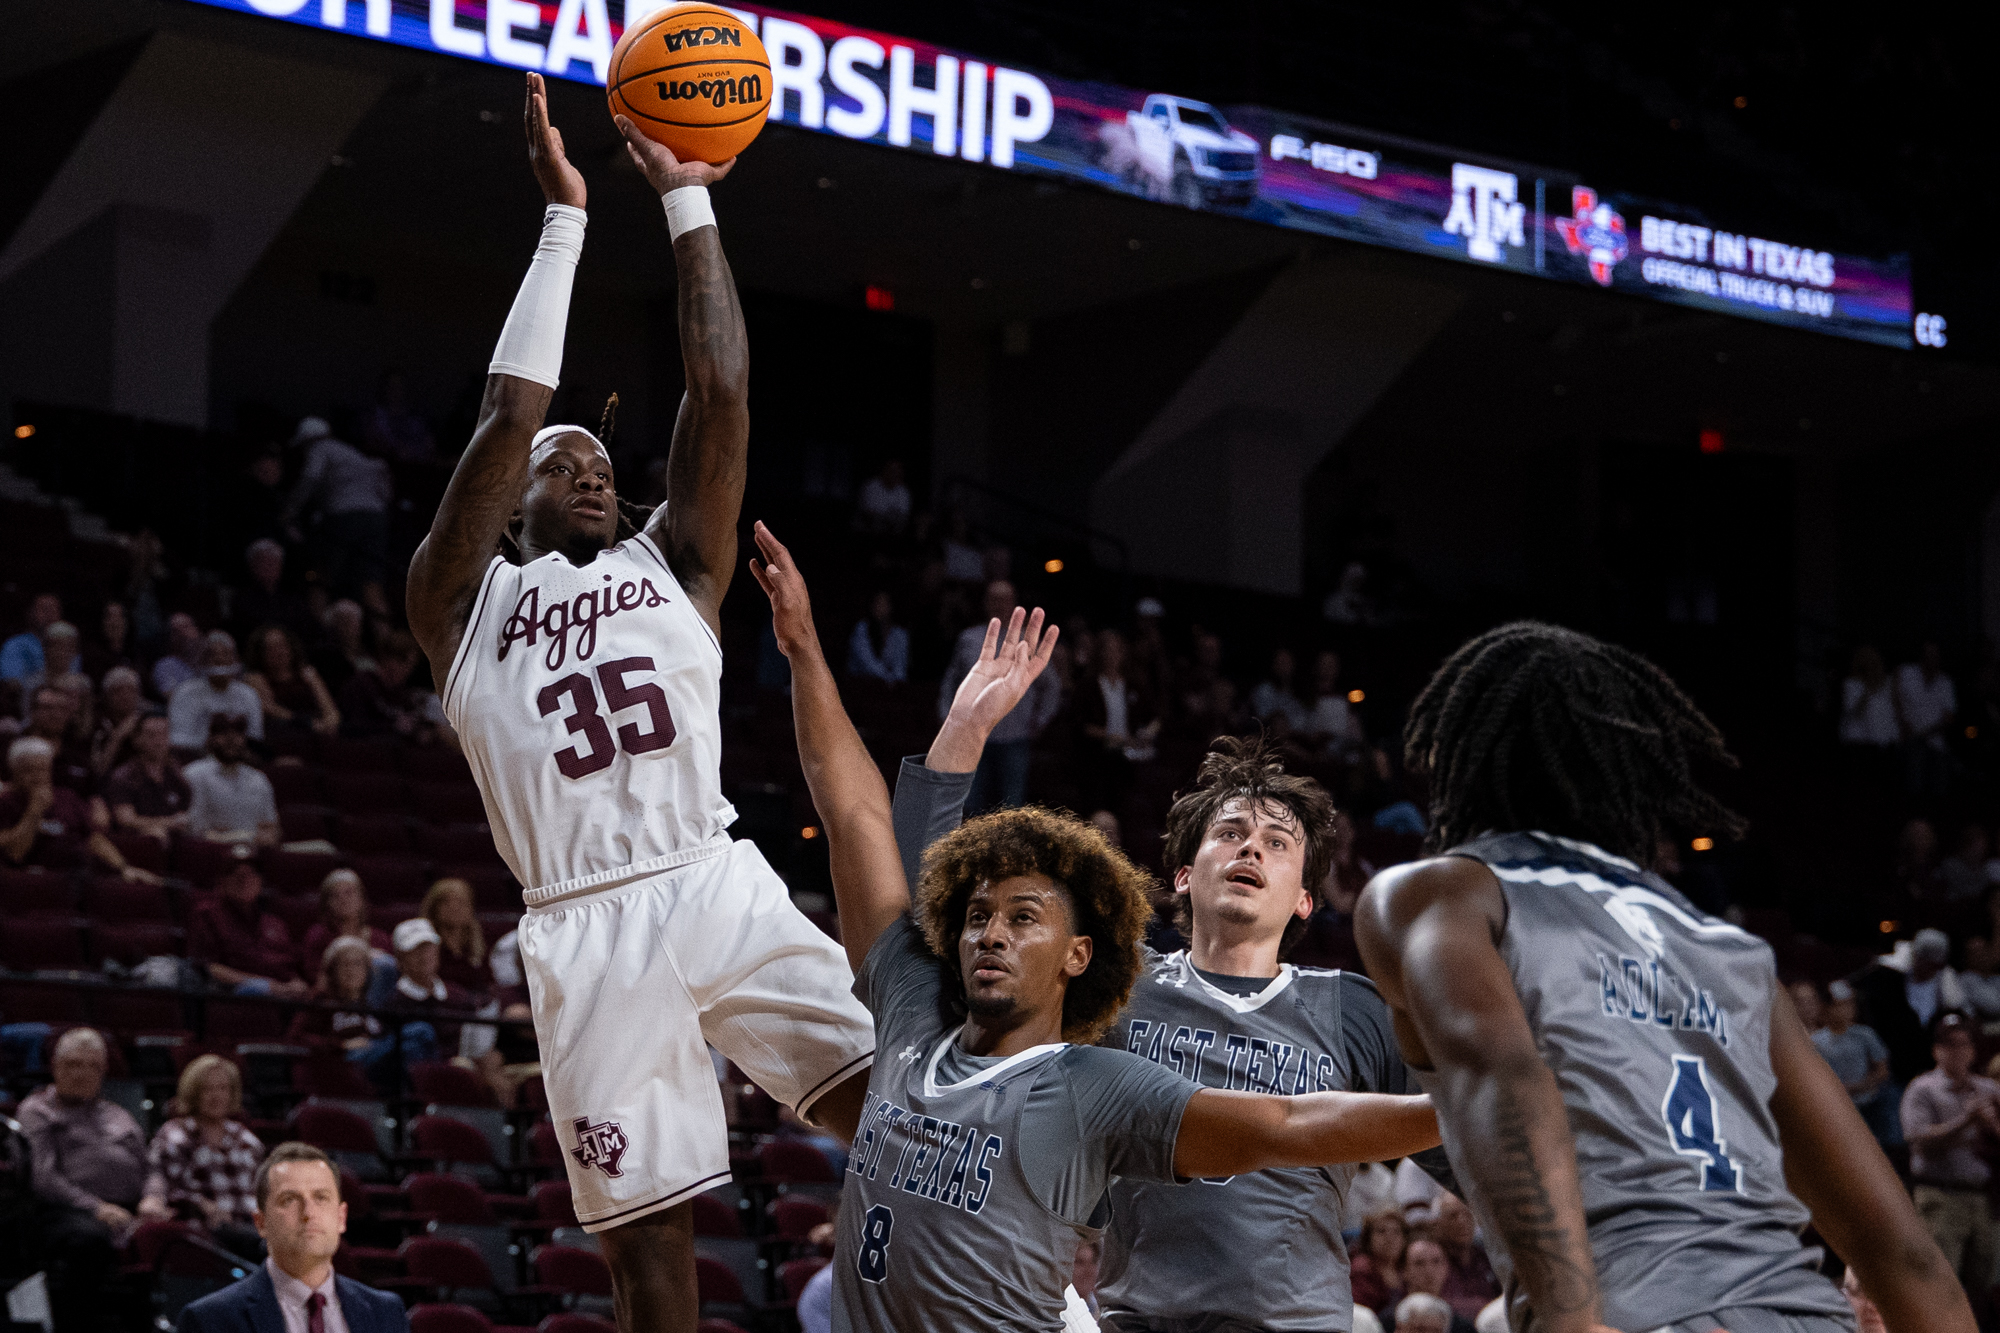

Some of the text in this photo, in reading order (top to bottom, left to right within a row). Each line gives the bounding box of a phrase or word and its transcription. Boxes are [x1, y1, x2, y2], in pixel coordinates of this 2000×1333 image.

[663, 26, 741, 53] NCAA
[429, 0, 1054, 168] LEARSHIP
[657, 74, 762, 108] Wilson
[1271, 134, 1377, 180] F-150
[1641, 215, 1713, 262] BEST
[1714, 230, 1747, 270] IN
[1748, 237, 1835, 287] TEXAS
[498, 574, 671, 671] Aggies
[537, 656, 677, 780] 35
[1223, 1034, 1333, 1095] TEXAS
[889, 1113, 1003, 1215] TEXAS
[1661, 1053, 1748, 1196] 4
[857, 1203, 894, 1285] 8
